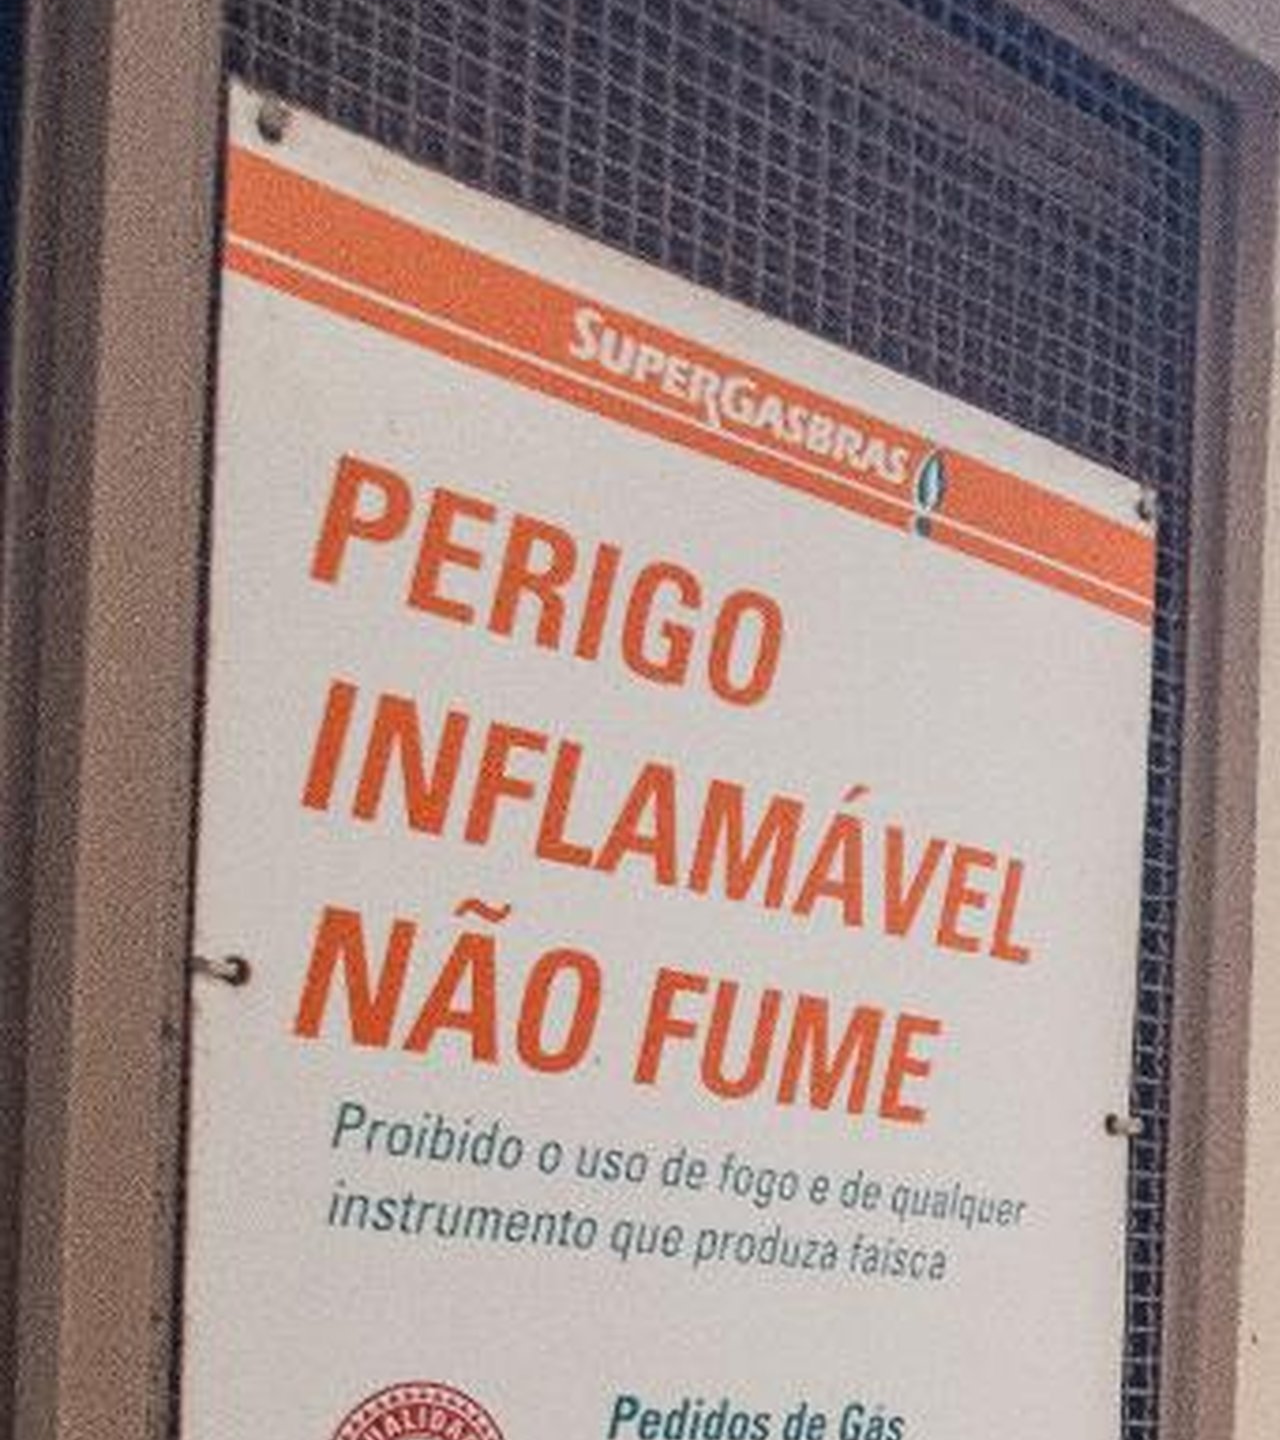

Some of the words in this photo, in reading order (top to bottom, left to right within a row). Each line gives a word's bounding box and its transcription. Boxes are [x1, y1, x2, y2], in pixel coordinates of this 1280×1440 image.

[310, 453, 785, 707] PERIGO
[301, 679, 1033, 965] INFLAMÁVEL
[294, 898, 603, 1074] NÃO
[634, 967, 943, 1124] FUME
[327, 1178, 600, 1251] instrumento
[609, 1216, 685, 1262] que
[693, 1224, 839, 1272] produza
[331, 1100, 525, 1171] Proibido
[538, 1140, 564, 1175] o
[575, 1145, 650, 1183] uso
[661, 1145, 708, 1191] de
[718, 1150, 801, 1210] fogo
[808, 1172, 831, 1206] e
[840, 1170, 882, 1210] de
[890, 1181, 1028, 1230] qualquer
